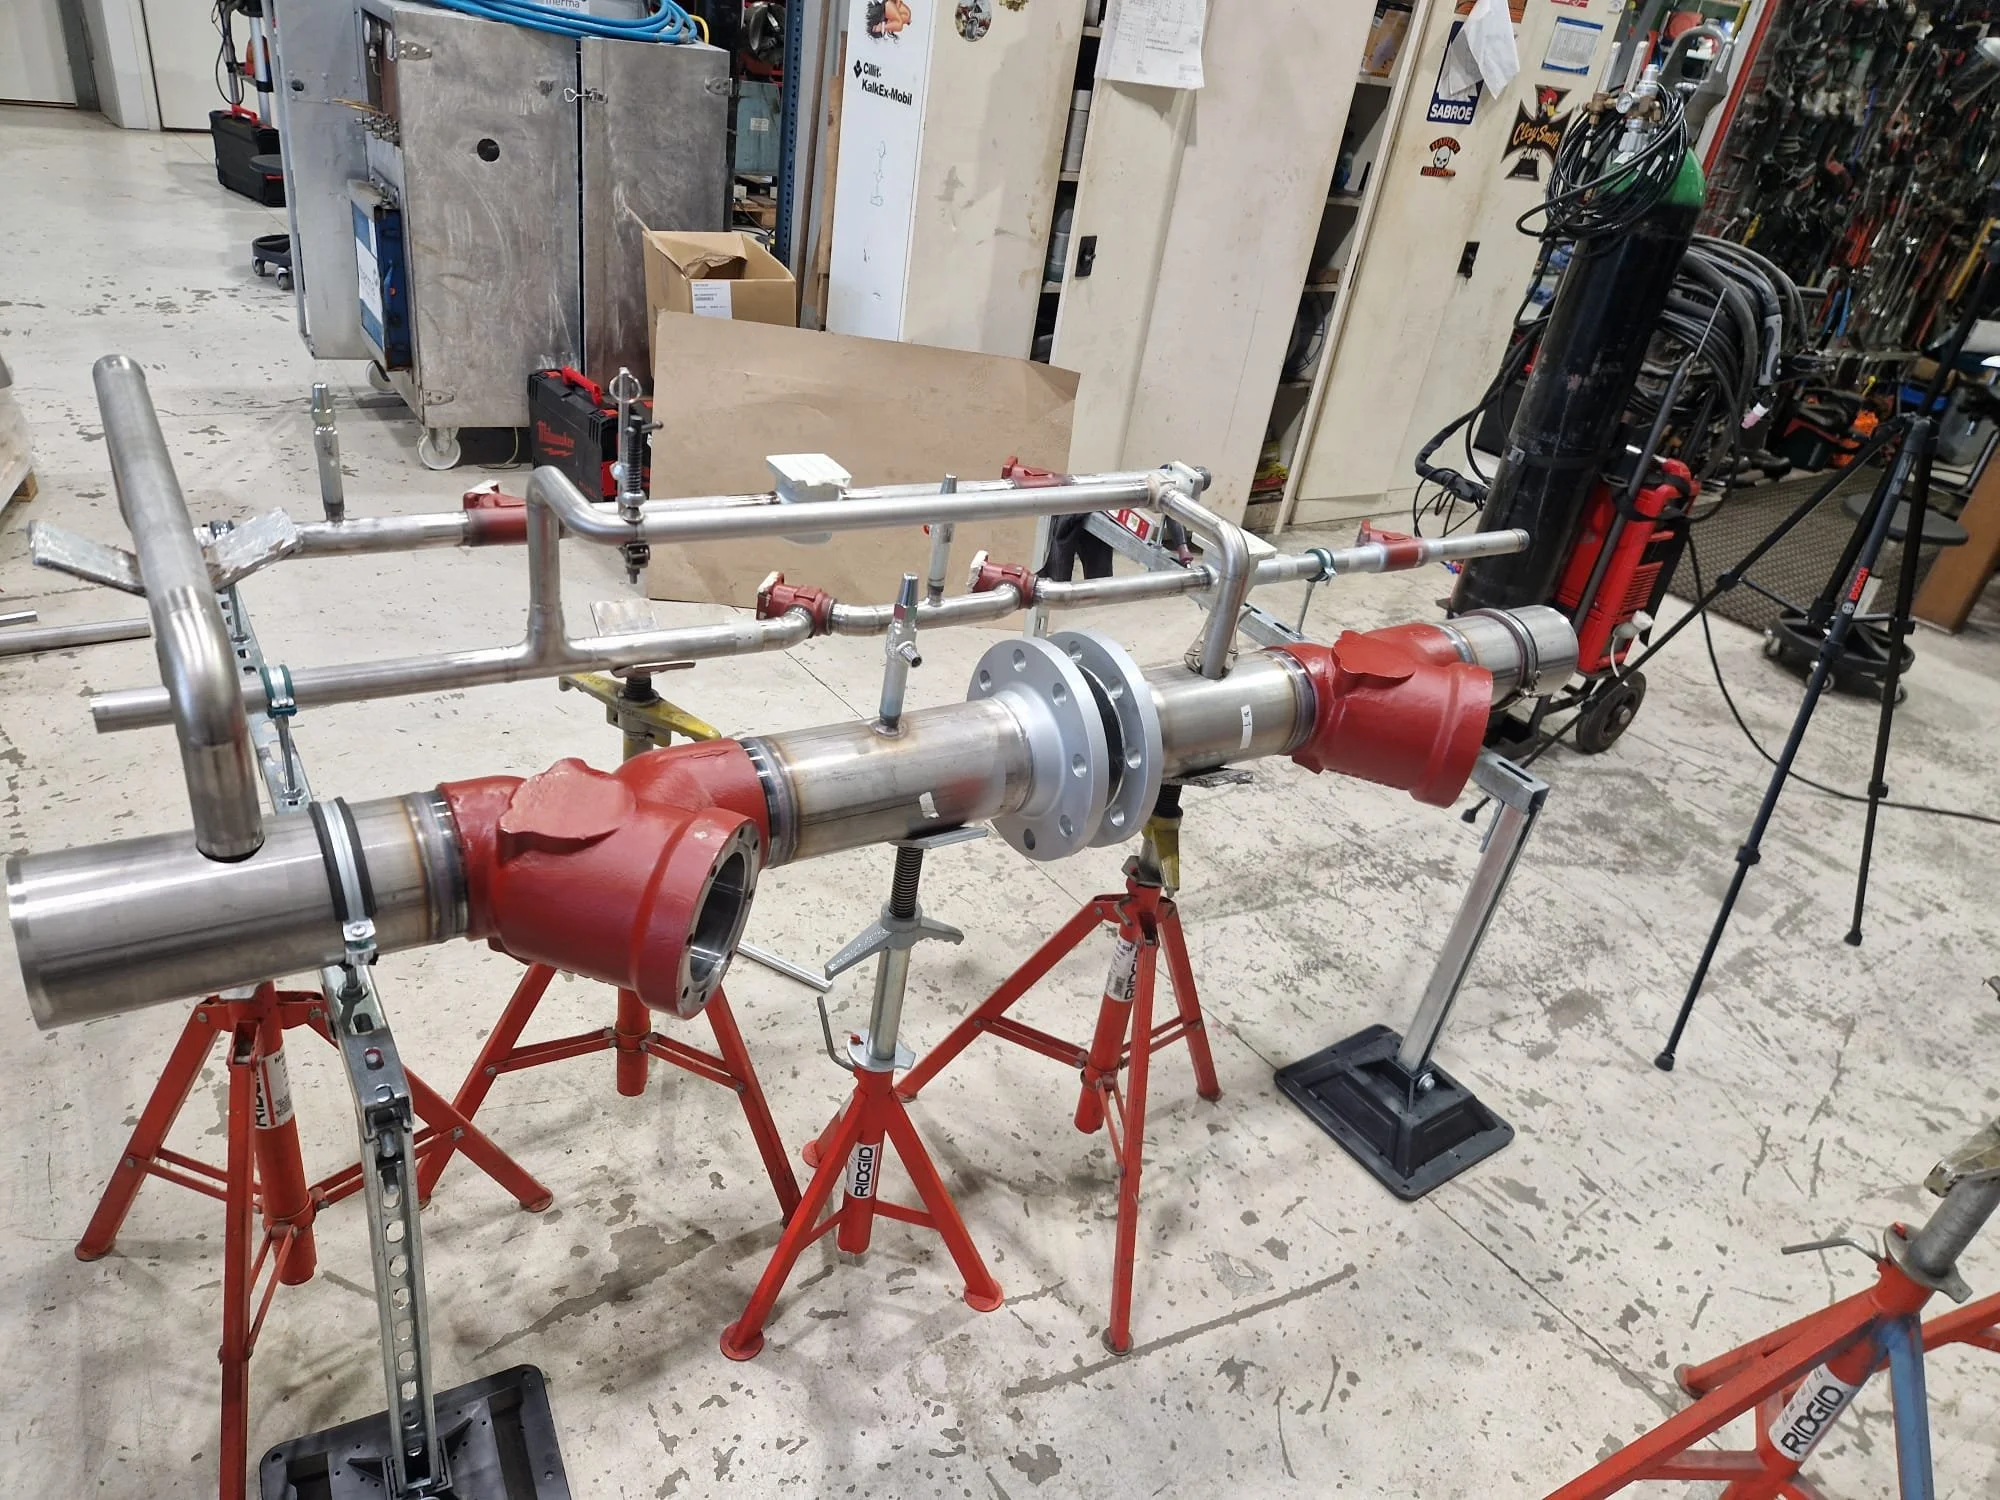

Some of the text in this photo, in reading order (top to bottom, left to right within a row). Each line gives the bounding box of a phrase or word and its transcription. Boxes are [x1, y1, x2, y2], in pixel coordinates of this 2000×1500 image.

[861, 79, 913, 106] KalkEx-Mobil
[1429, 103, 1474, 121] SABROE
[1512, 121, 1561, 150] Clay Smith
[1848, 566, 1869, 601] BOSCH
[853, 1146, 874, 1197] RIDGID
[1780, 1385, 1844, 1455] RIDGID
